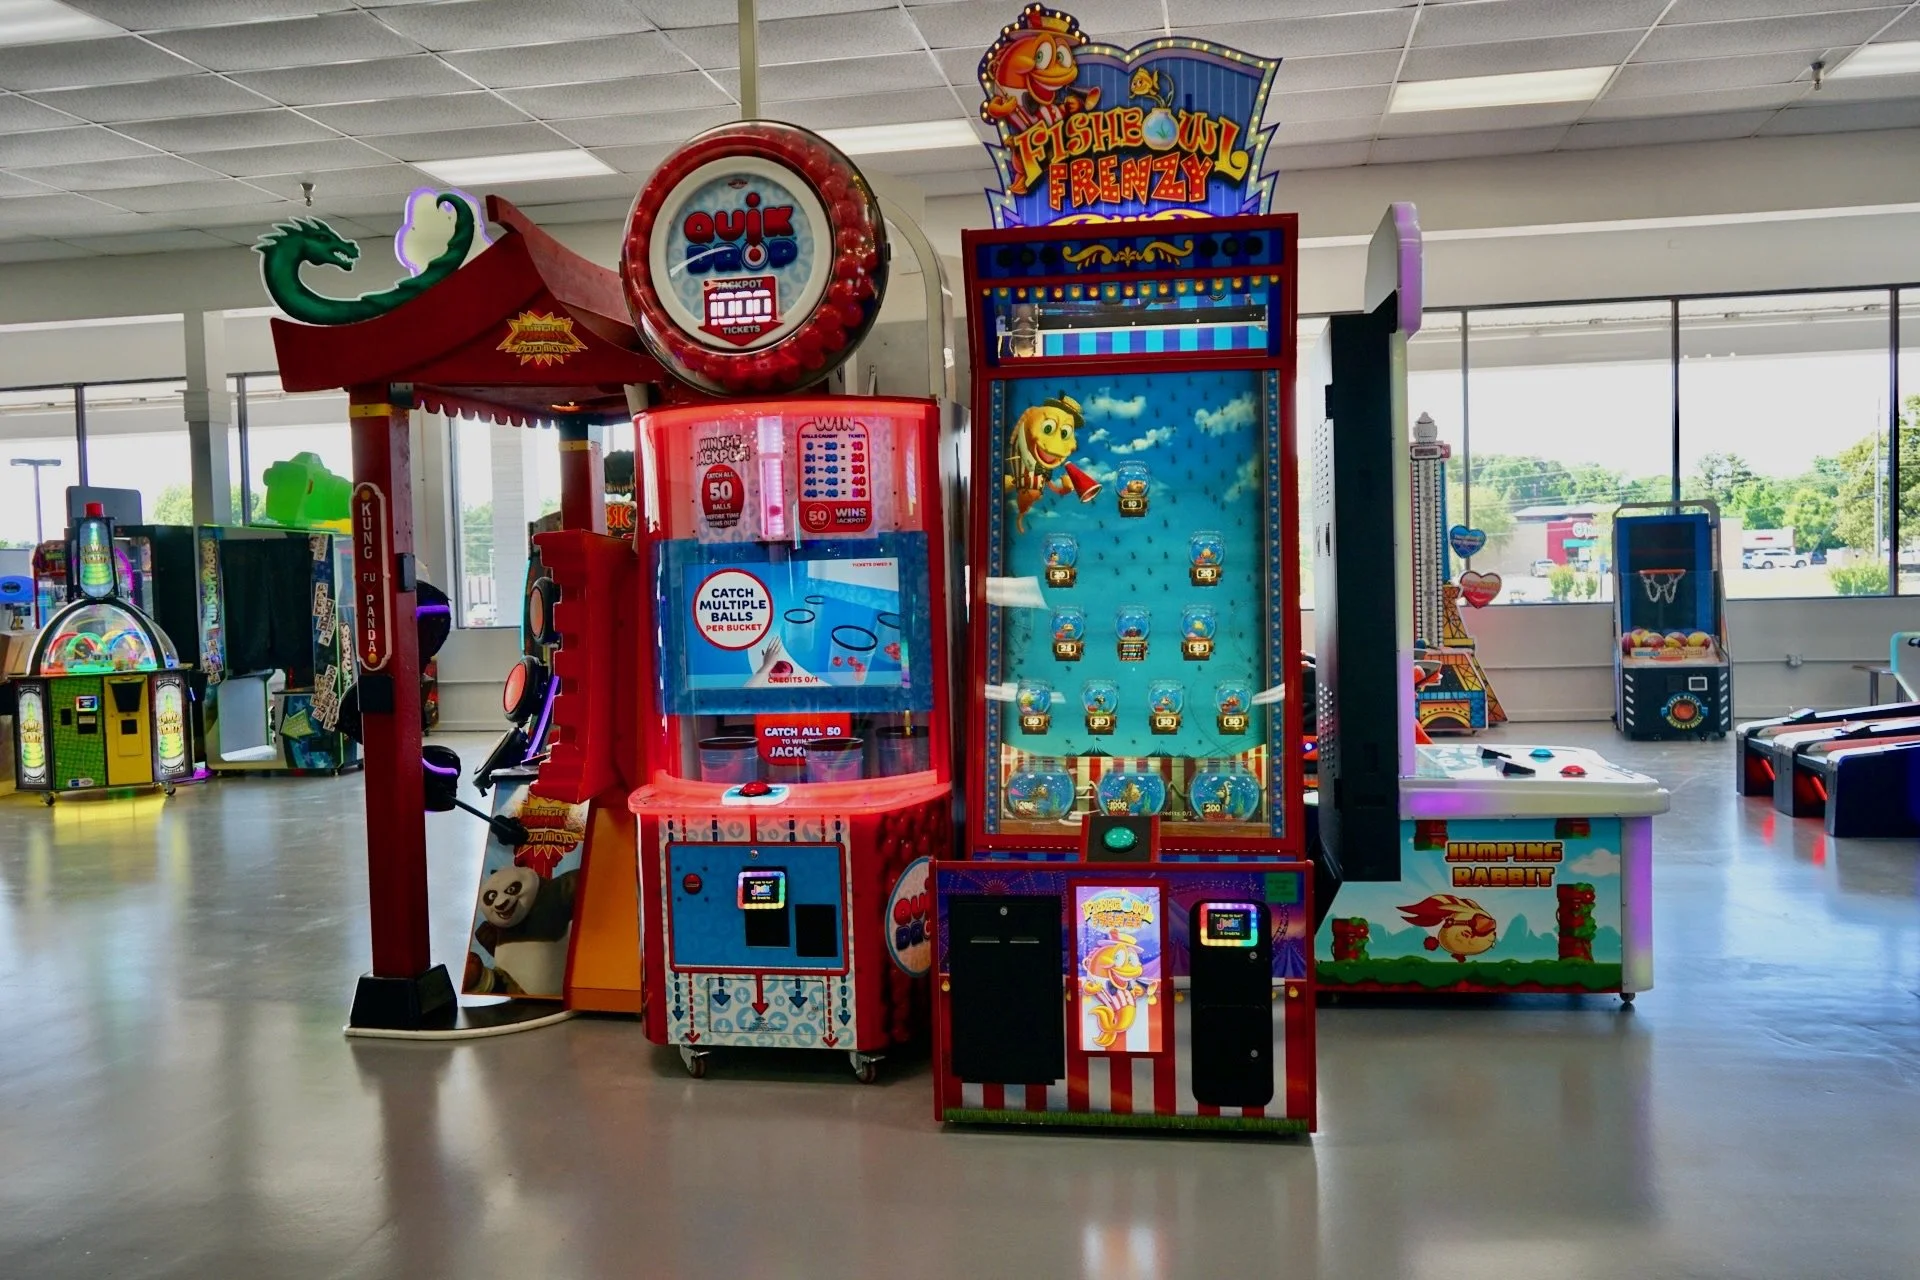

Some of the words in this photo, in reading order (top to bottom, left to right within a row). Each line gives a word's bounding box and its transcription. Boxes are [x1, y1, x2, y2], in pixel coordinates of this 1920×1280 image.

[1049, 152, 1213, 211] FRENZY
[686, 237, 798, 275] DROP
[717, 279, 763, 290] JACKPOT
[722, 325, 761, 335] TICKETS
[543, 343, 570, 353] MOJO
[813, 415, 856, 431] WIN
[699, 437, 718, 451] WIN
[718, 434, 742, 449] THE
[851, 441, 864, 451] 10
[709, 480, 733, 500] 50
[808, 510, 827, 521] 50
[835, 507, 867, 517] WINS
[361, 502, 373, 560] KUNG
[363, 573, 376, 582] FU
[711, 588, 754, 598] CATCH
[699, 600, 767, 610] MULTIPLE
[711, 612, 753, 622] BALLS
[366, 595, 377, 652] PANDA
[706, 624, 724, 632] PER
[726, 623, 762, 631] BUCKET
[764, 727, 798, 737] CATCH
[801, 727, 823, 736] ALL
[826, 726, 841, 736] 50
[769, 746, 807, 758] JACK
[1206, 804, 1220, 812] 200
[545, 831, 575, 844] MOJO
[1445, 841, 1563, 862] JUMPING
[1452, 867, 1555, 887] RABBIT
